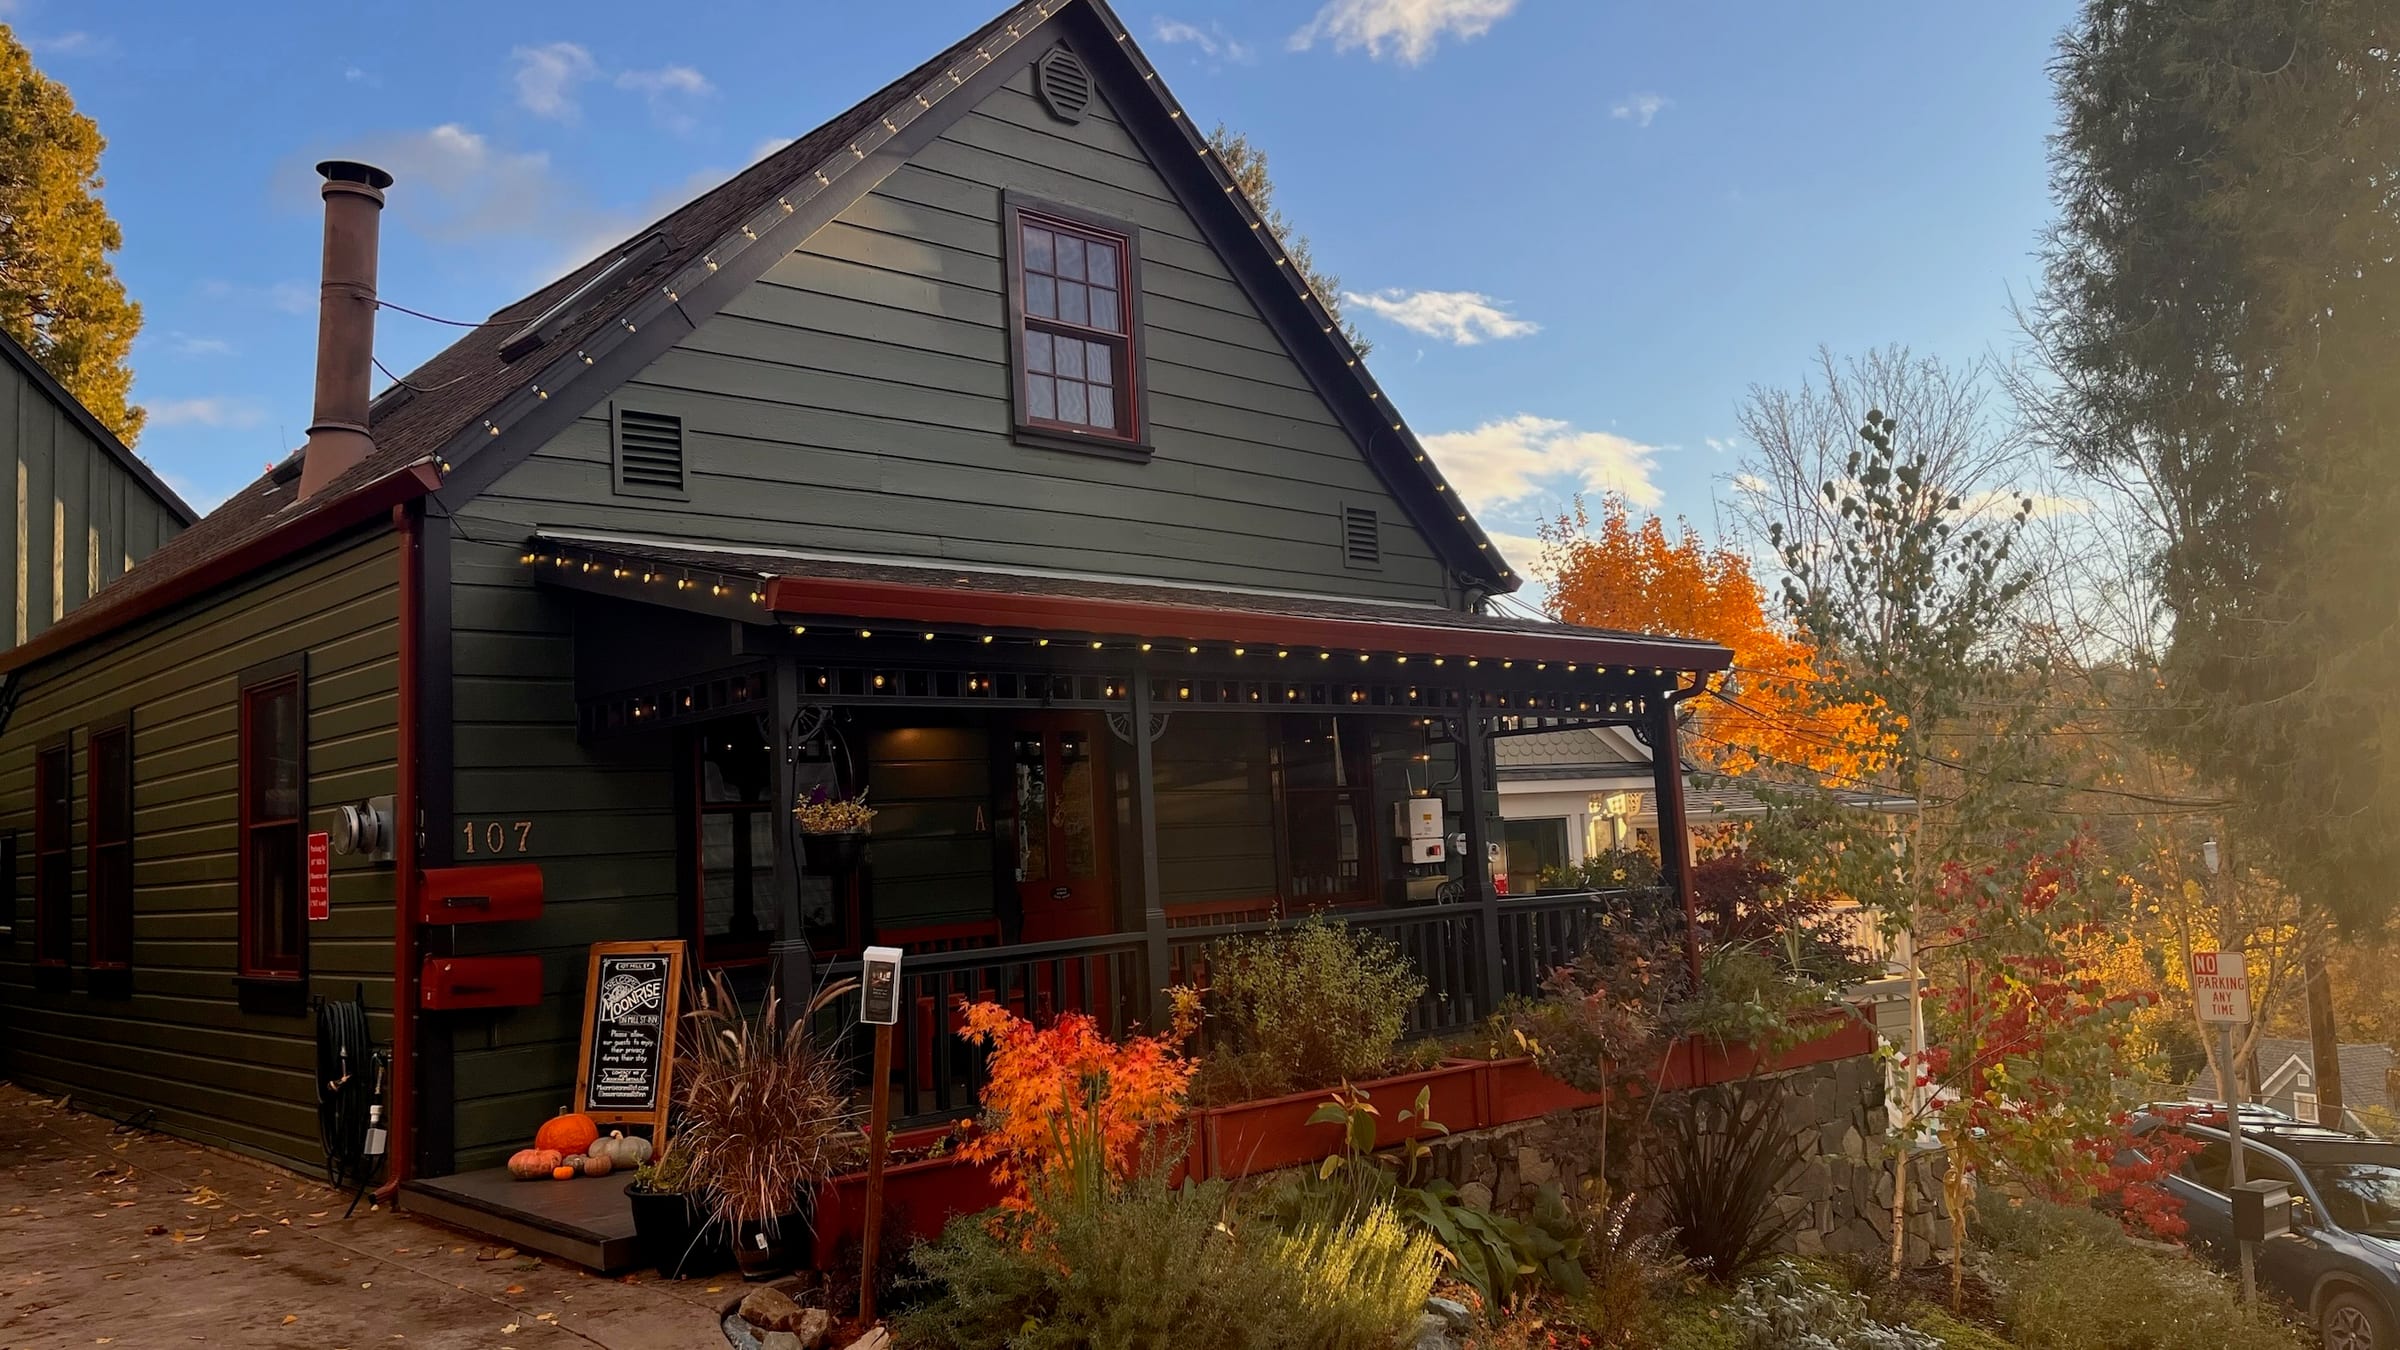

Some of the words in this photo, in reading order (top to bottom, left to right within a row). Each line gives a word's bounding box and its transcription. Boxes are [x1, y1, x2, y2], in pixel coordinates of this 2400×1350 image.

[463, 821, 532, 853] 107
[2195, 955, 2216, 973] NO
[2197, 976, 2245, 990] PARKING
[2212, 991, 2232, 1002] ANY
[2212, 1003, 2236, 1015] TIME
